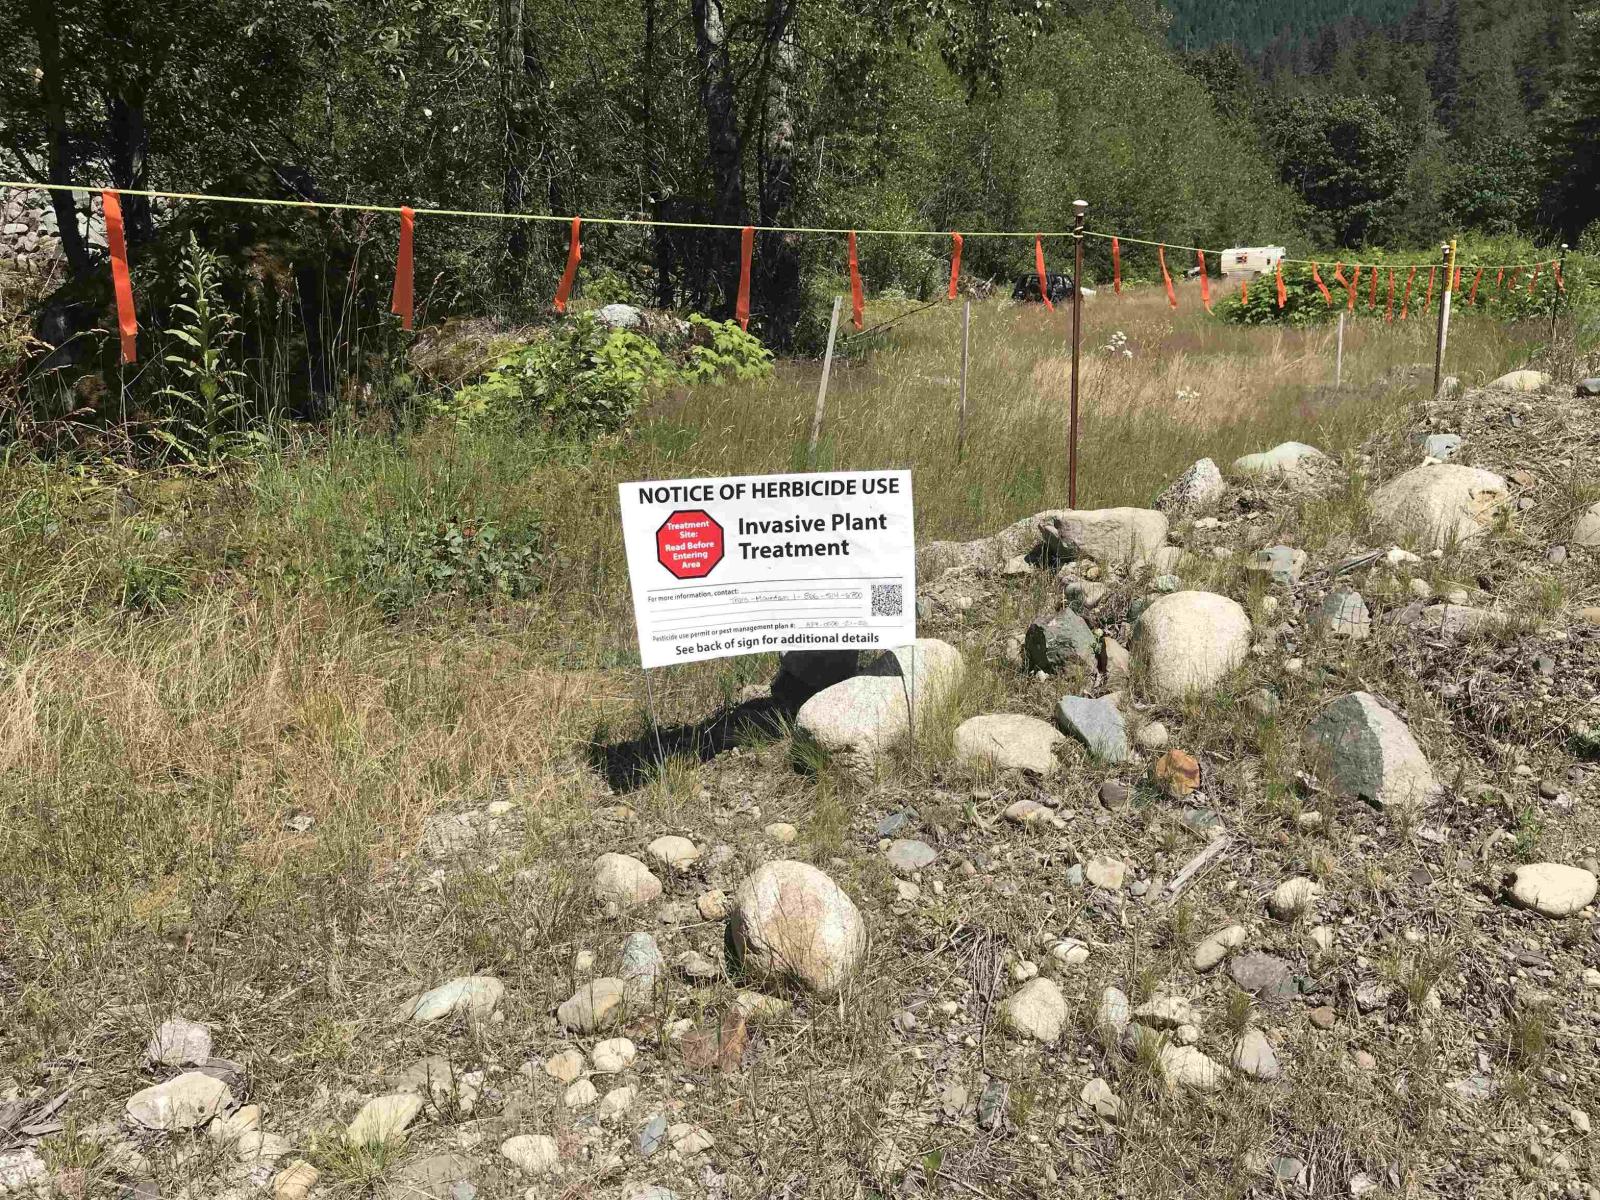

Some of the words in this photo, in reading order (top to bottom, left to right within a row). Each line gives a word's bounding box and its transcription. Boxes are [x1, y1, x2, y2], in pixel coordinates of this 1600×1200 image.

[639, 485, 714, 504] NOTICE
[720, 483, 746, 500] OF
[752, 480, 856, 499] HERBICIDE
[862, 478, 900, 494] USE
[667, 521, 710, 531] Treatment
[739, 515, 826, 535] Invasive
[832, 513, 887, 531] Plant
[679, 531, 699, 539] Site:
[665, 543, 686, 552] Read
[687, 540, 715, 549] Before
[738, 540, 849, 560] Treatment
[673, 550, 708, 560] Entering
[682, 561, 701, 569] Area
[714, 589, 740, 597] contact:
[652, 633, 678, 642] Pesticide
[690, 630, 710, 640] permit
[719, 628, 732, 637] pest
[733, 623, 773, 634] management
[774, 622, 789, 631] plan
[676, 645, 694, 655] See
[697, 641, 722, 653] back
[724, 638, 735, 649] of
[737, 636, 759, 649] sign
[762, 635, 778, 645] for
[781, 632, 839, 644] additional
[841, 632, 880, 643] details
